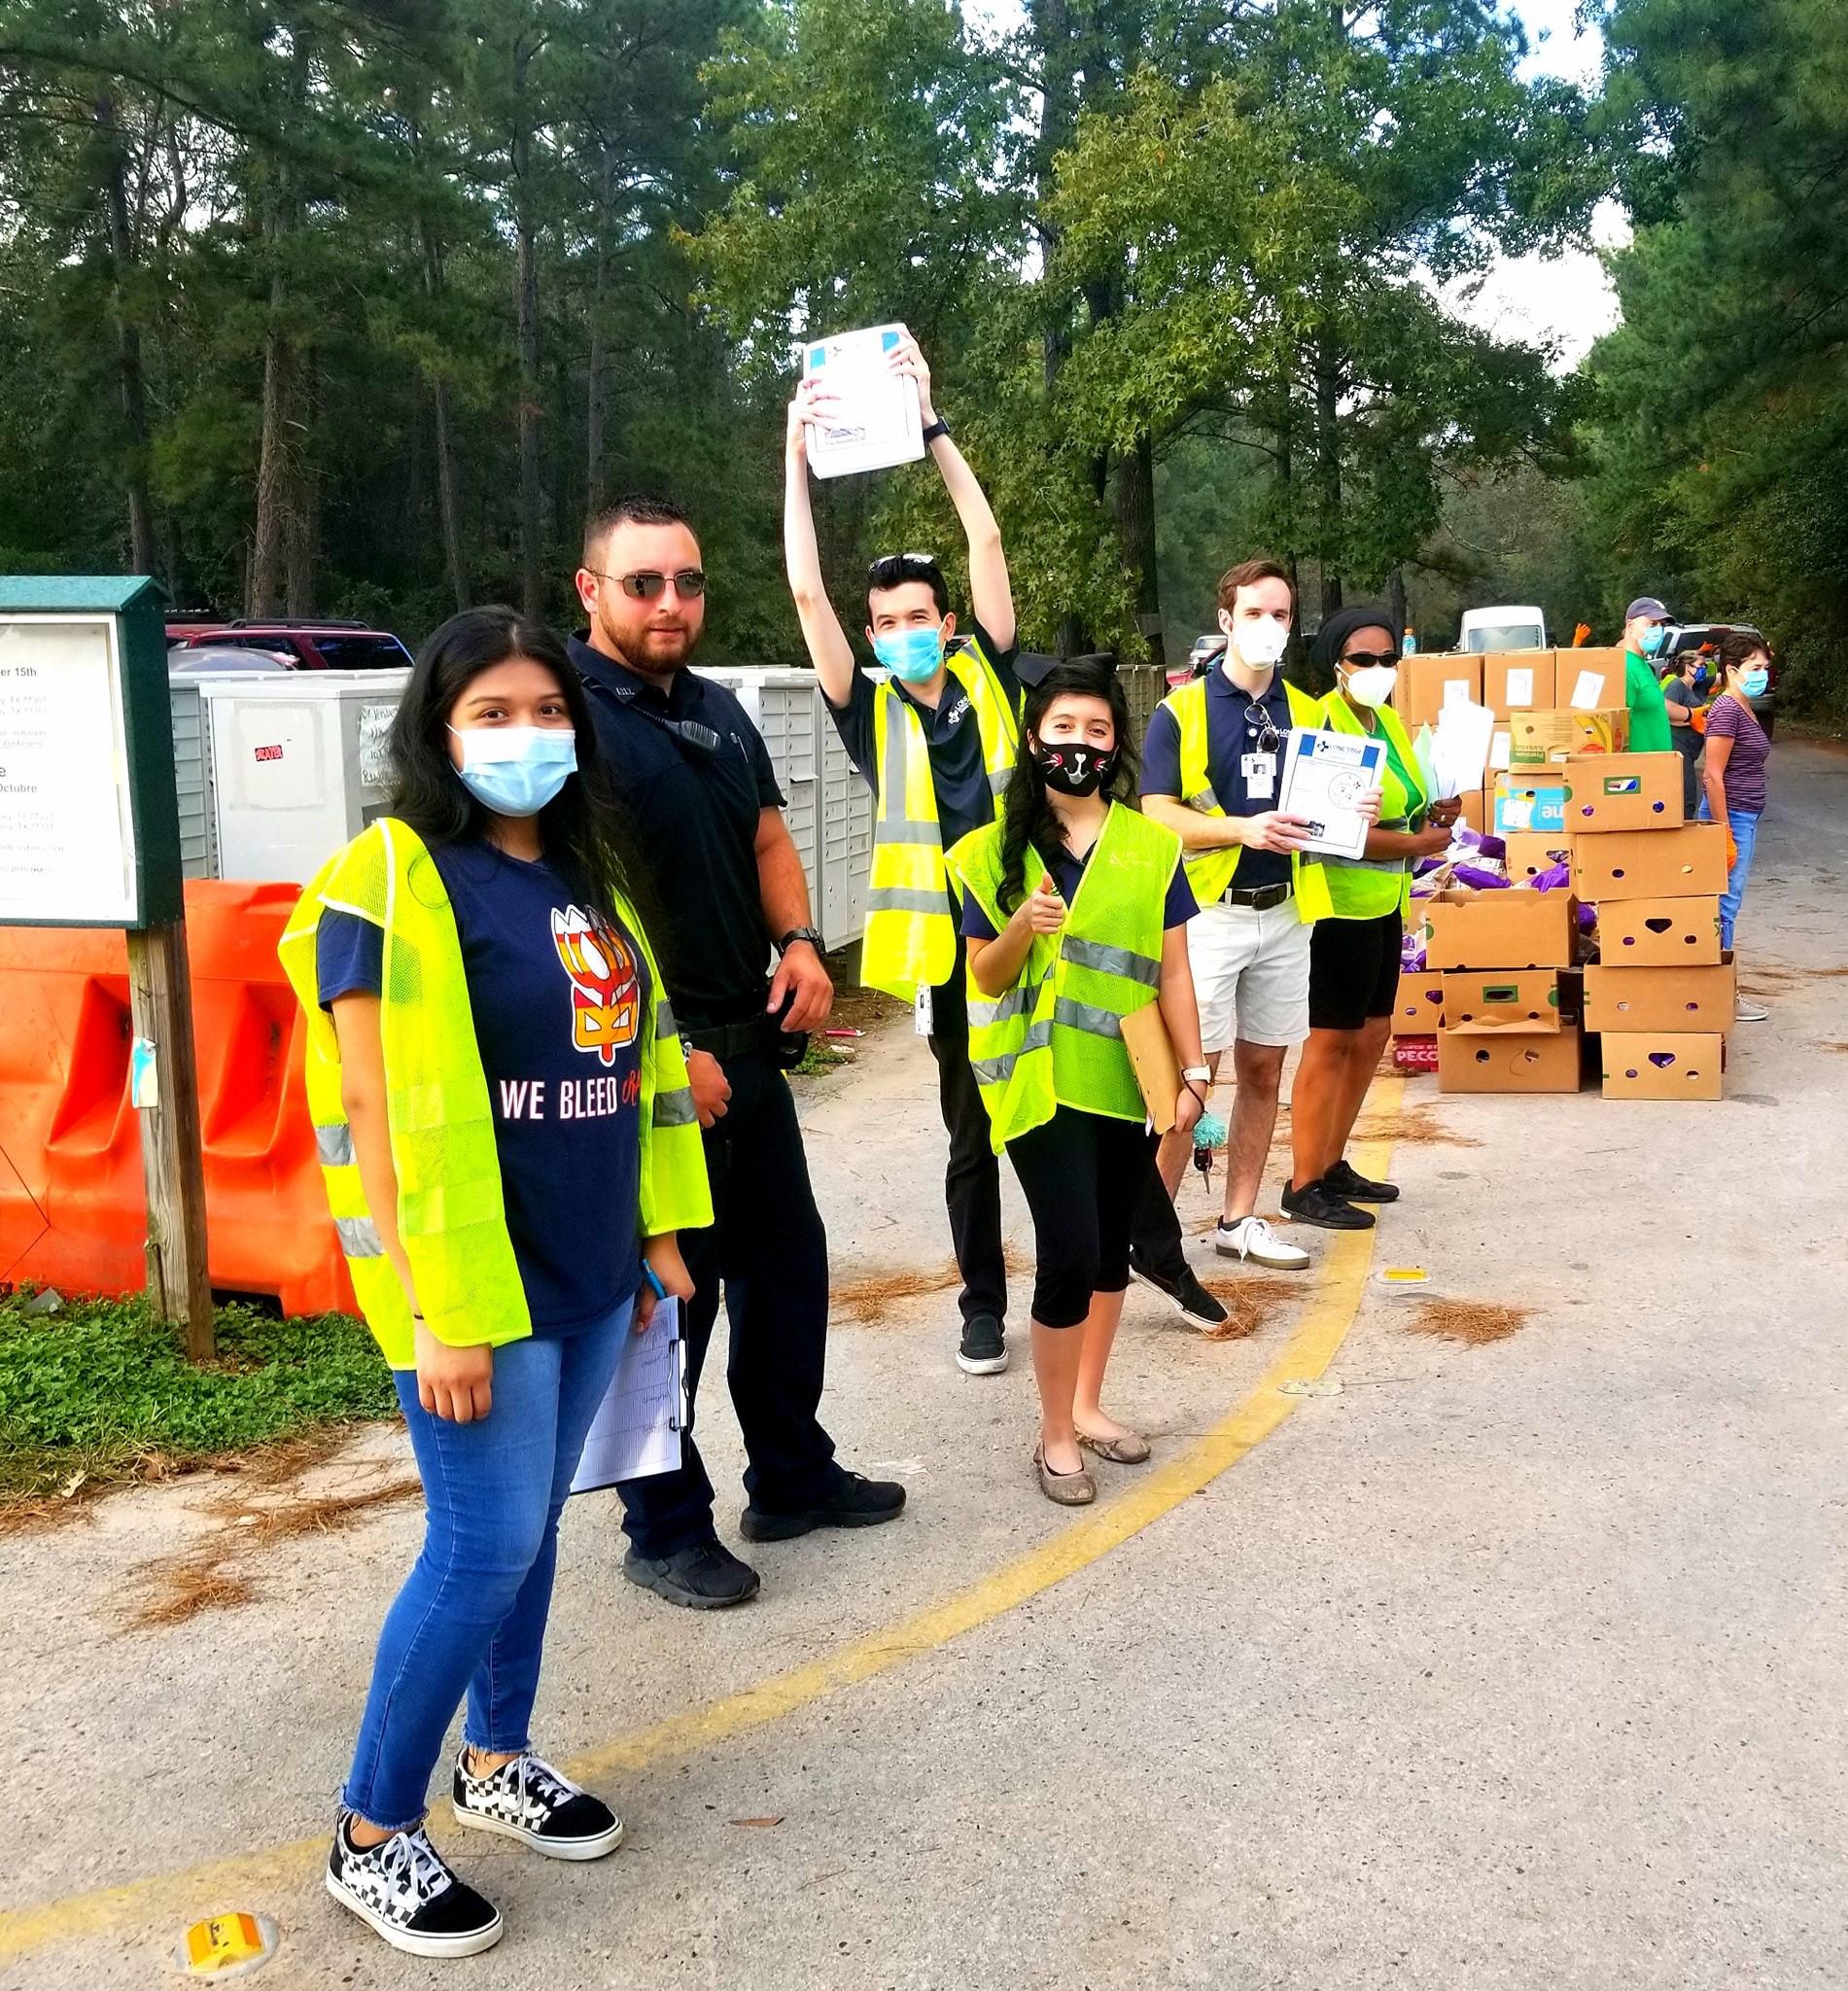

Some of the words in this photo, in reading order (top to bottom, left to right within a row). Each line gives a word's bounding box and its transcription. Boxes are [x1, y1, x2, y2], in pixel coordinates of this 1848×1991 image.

[15, 666, 38, 678] 15th
[499, 1079, 545, 1120] WE
[559, 1076, 618, 1120] BLEED
